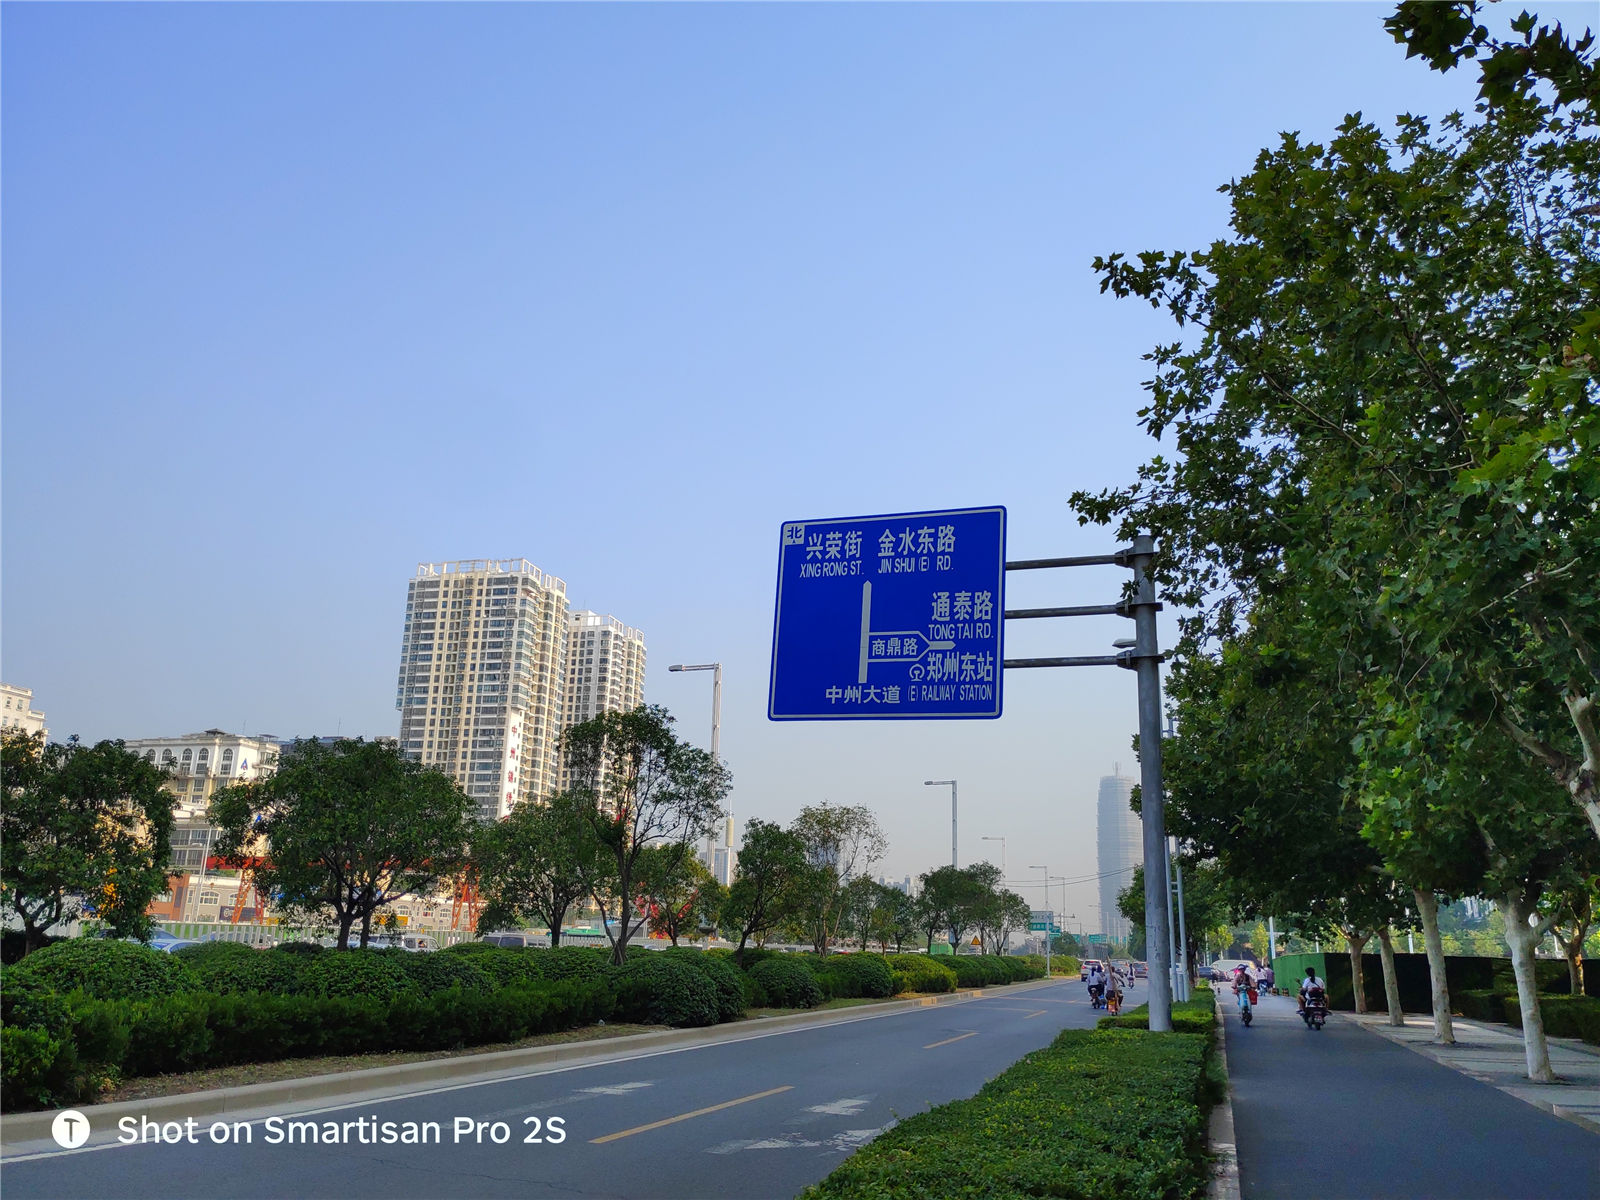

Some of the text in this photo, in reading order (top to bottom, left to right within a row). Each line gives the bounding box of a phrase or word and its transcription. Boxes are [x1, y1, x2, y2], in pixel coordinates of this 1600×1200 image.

[786, 526, 803, 539] 北
[878, 524, 956, 557] 金水东路
[806, 530, 862, 560] 兴荣街
[800, 563, 821, 578] XING
[822, 561, 848, 576] RONG
[878, 558, 892, 574] JIN
[894, 557, 915, 573] SHUI
[931, 590, 993, 622] 通泰路
[928, 624, 955, 640] TONG
[957, 623, 973, 639] TAI
[872, 637, 918, 656] 商鼎路
[926, 651, 993, 682] 郑州东站
[825, 685, 901, 704] 中州大道
[921, 685, 956, 701] RAILWAY
[959, 684, 992, 701] STATION
